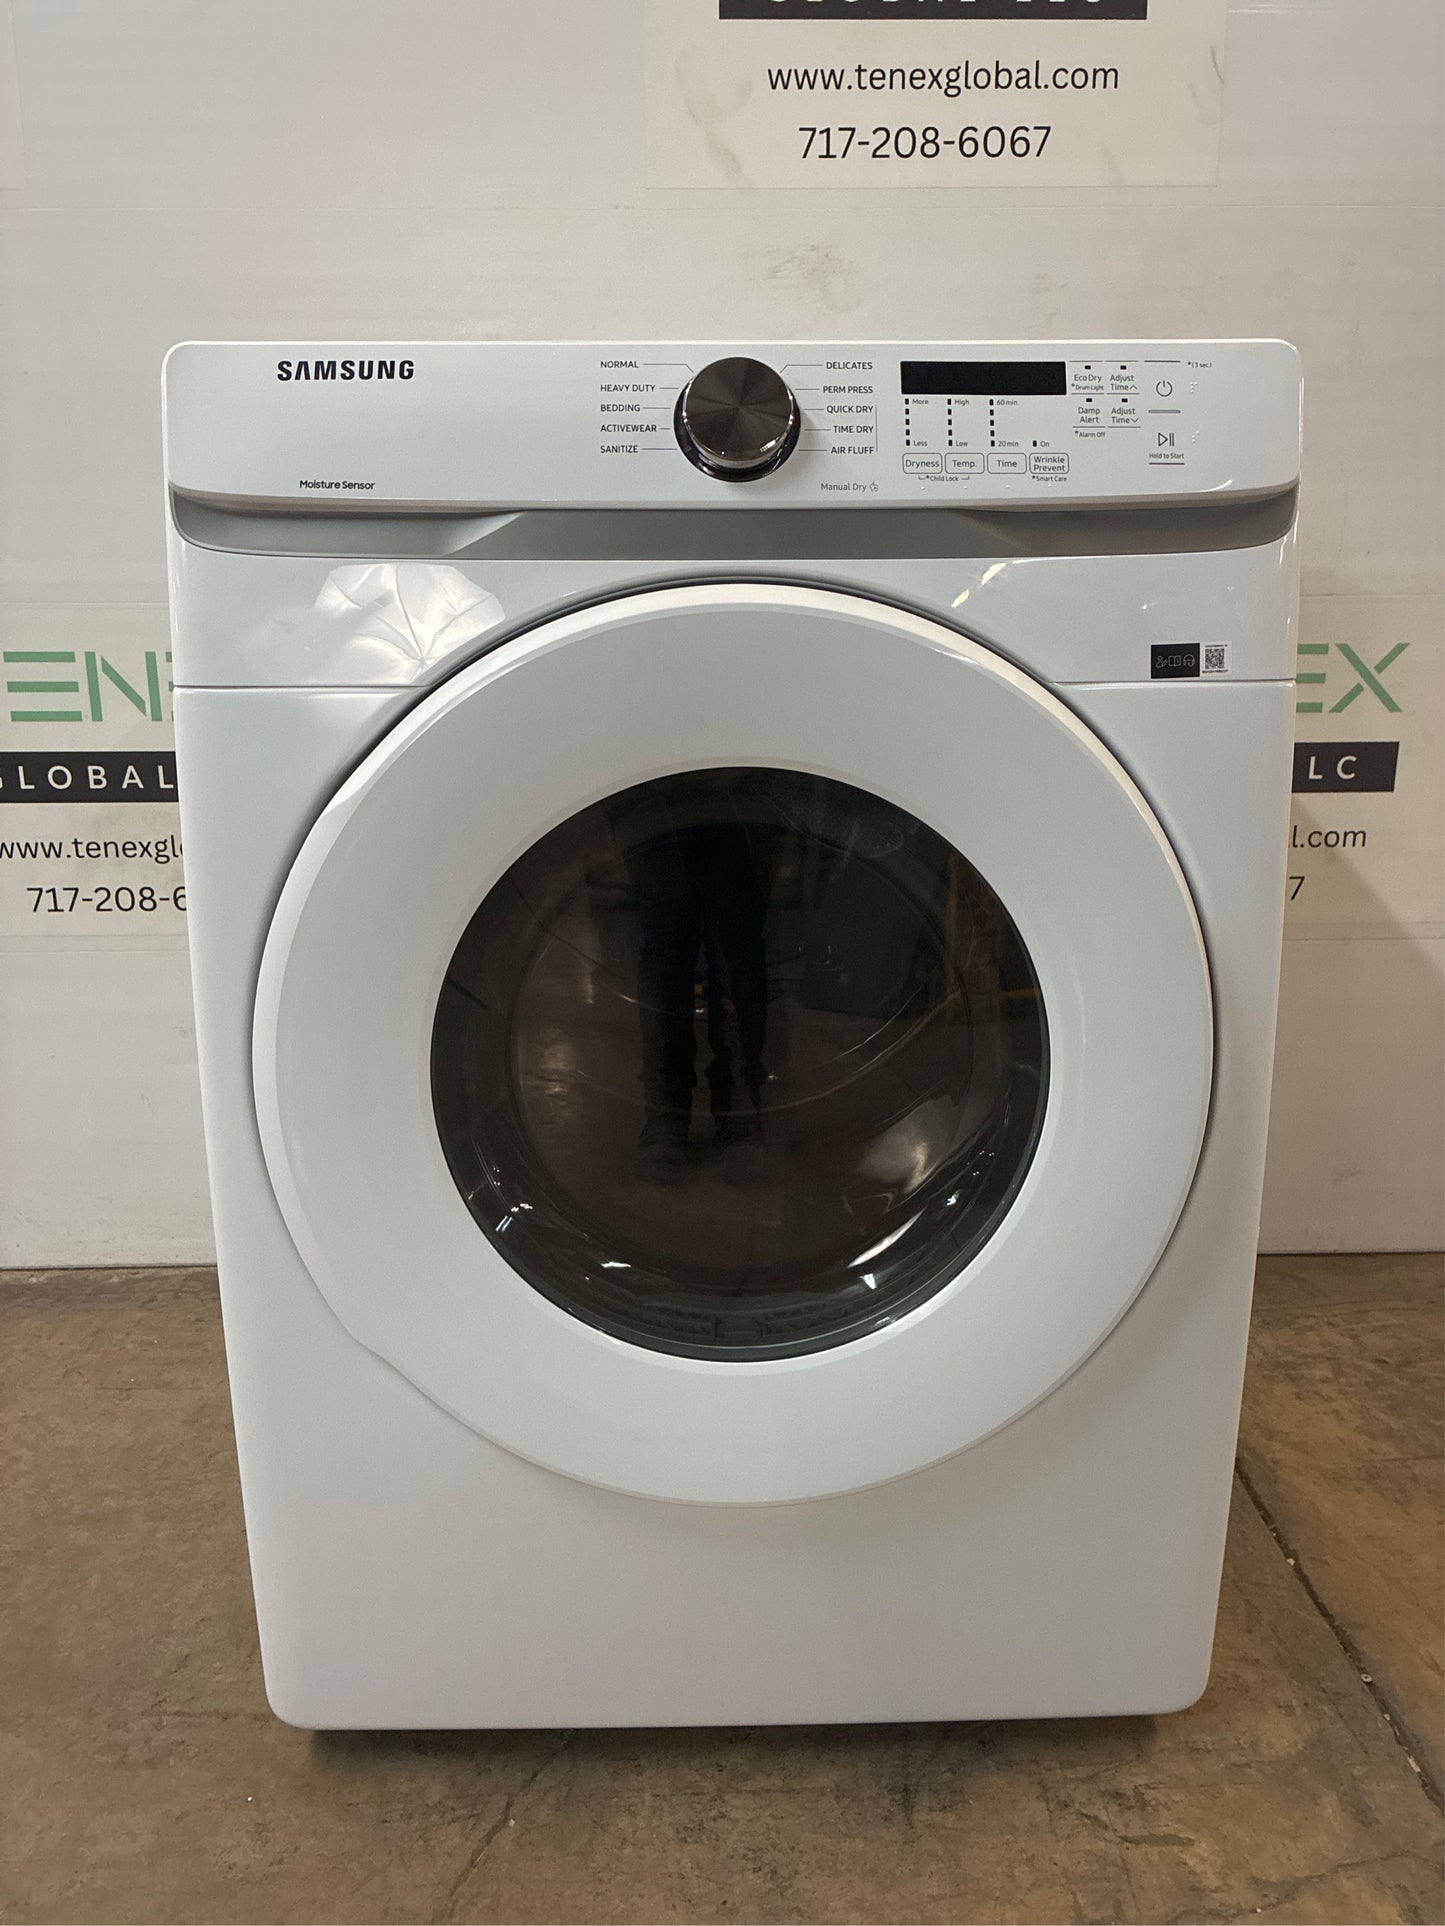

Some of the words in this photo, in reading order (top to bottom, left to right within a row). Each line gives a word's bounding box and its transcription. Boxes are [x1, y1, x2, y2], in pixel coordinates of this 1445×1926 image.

[767, 61, 1120, 98] www.tenexglobal.com
[798, 126, 1053, 160] 717-208-6067
[600, 360, 640, 369] NORMAL
[826, 361, 873, 370] DELICATES
[277, 360, 415, 381] SAMSUNG
[1074, 374, 1087, 382] Eco
[1088, 374, 1102, 383] Dry
[1110, 374, 1135, 383] Adjust
[600, 383, 629, 392] HEAVY
[631, 383, 656, 392] DUTY
[823, 385, 846, 394] PERM
[848, 385, 873, 394] PRESS
[1111, 383, 1129, 391] Time
[954, 398, 970, 406] High
[996, 398, 1006, 406] 60
[1006, 398, 1018, 406] min
[600, 403, 641, 413] BEDDING
[826, 404, 853, 414] QUICK
[855, 404, 873, 414] DRY
[1078, 406, 1101, 415] Damp
[1111, 407, 1136, 416] Adjust
[1080, 415, 1100, 424] Alert
[1112, 416, 1130, 424] Time
[600, 423, 657, 433] ACTIVEWEAR
[833, 424, 853, 433] TIME
[855, 424, 873, 433] DRY
[600, 444, 638, 453] SANITIZE
[830, 445, 845, 454] AIR
[847, 445, 874, 454] FLUFF
[1033, 456, 1065, 464] Wrinkle
[1170, 452, 1184, 460] Start
[905, 459, 940, 469] Dryness
[952, 459, 977, 469] Temp.
[996, 459, 1018, 468] Time
[1033, 464, 1065, 472] Prevent
[300, 480, 341, 489] Moisture
[342, 480, 375, 490] Sensor
[820, 482, 850, 491] Manual
[852, 482, 867, 493] Dry
[3, 651, 172, 721] EN
[0, 765, 174, 790] LOBAL
[1288, 825, 1367, 849] l.com
[0, 834, 183, 864] www.tenexgl
[1289, 876, 1305, 900] 7
[26, 886, 187, 912] 717-208-6
